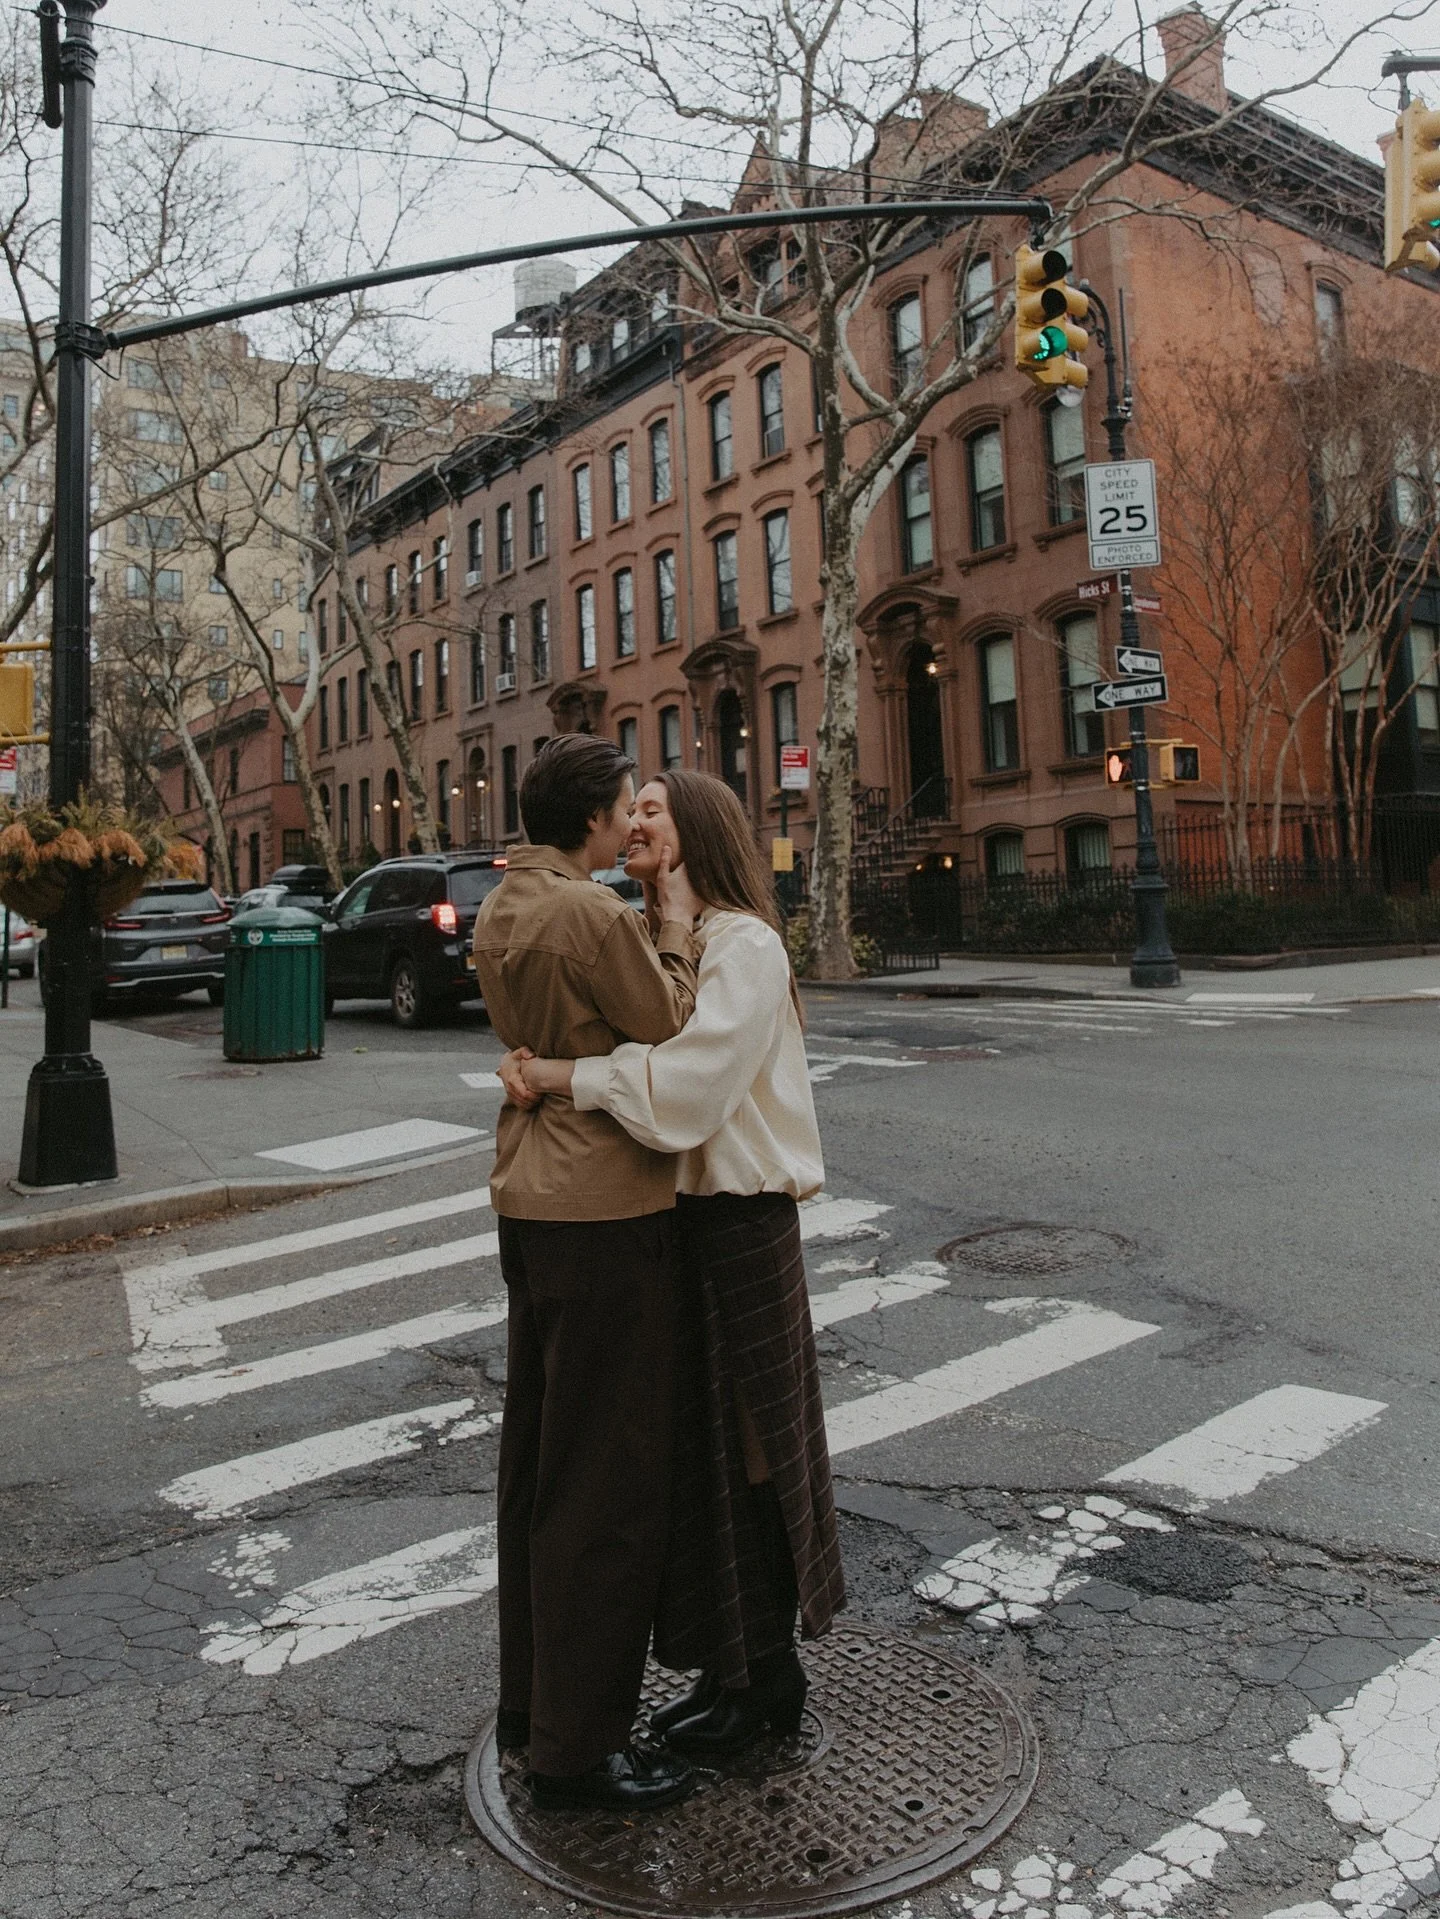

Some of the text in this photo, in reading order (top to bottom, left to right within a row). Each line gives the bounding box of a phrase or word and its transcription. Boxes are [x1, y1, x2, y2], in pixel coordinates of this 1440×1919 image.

[1104, 468, 1131, 478] CITY
[1100, 479, 1139, 490] SPEED
[1105, 491, 1135, 502] LIMIT
[1099, 505, 1148, 534] 25
[1107, 544, 1142, 554] PHOTO
[1098, 553, 1153, 564] ENFORCED
[1078, 581, 1110, 599] Hicks St
[1124, 656, 1138, 668] ONE
[1104, 683, 1156, 701] ONE WAY
